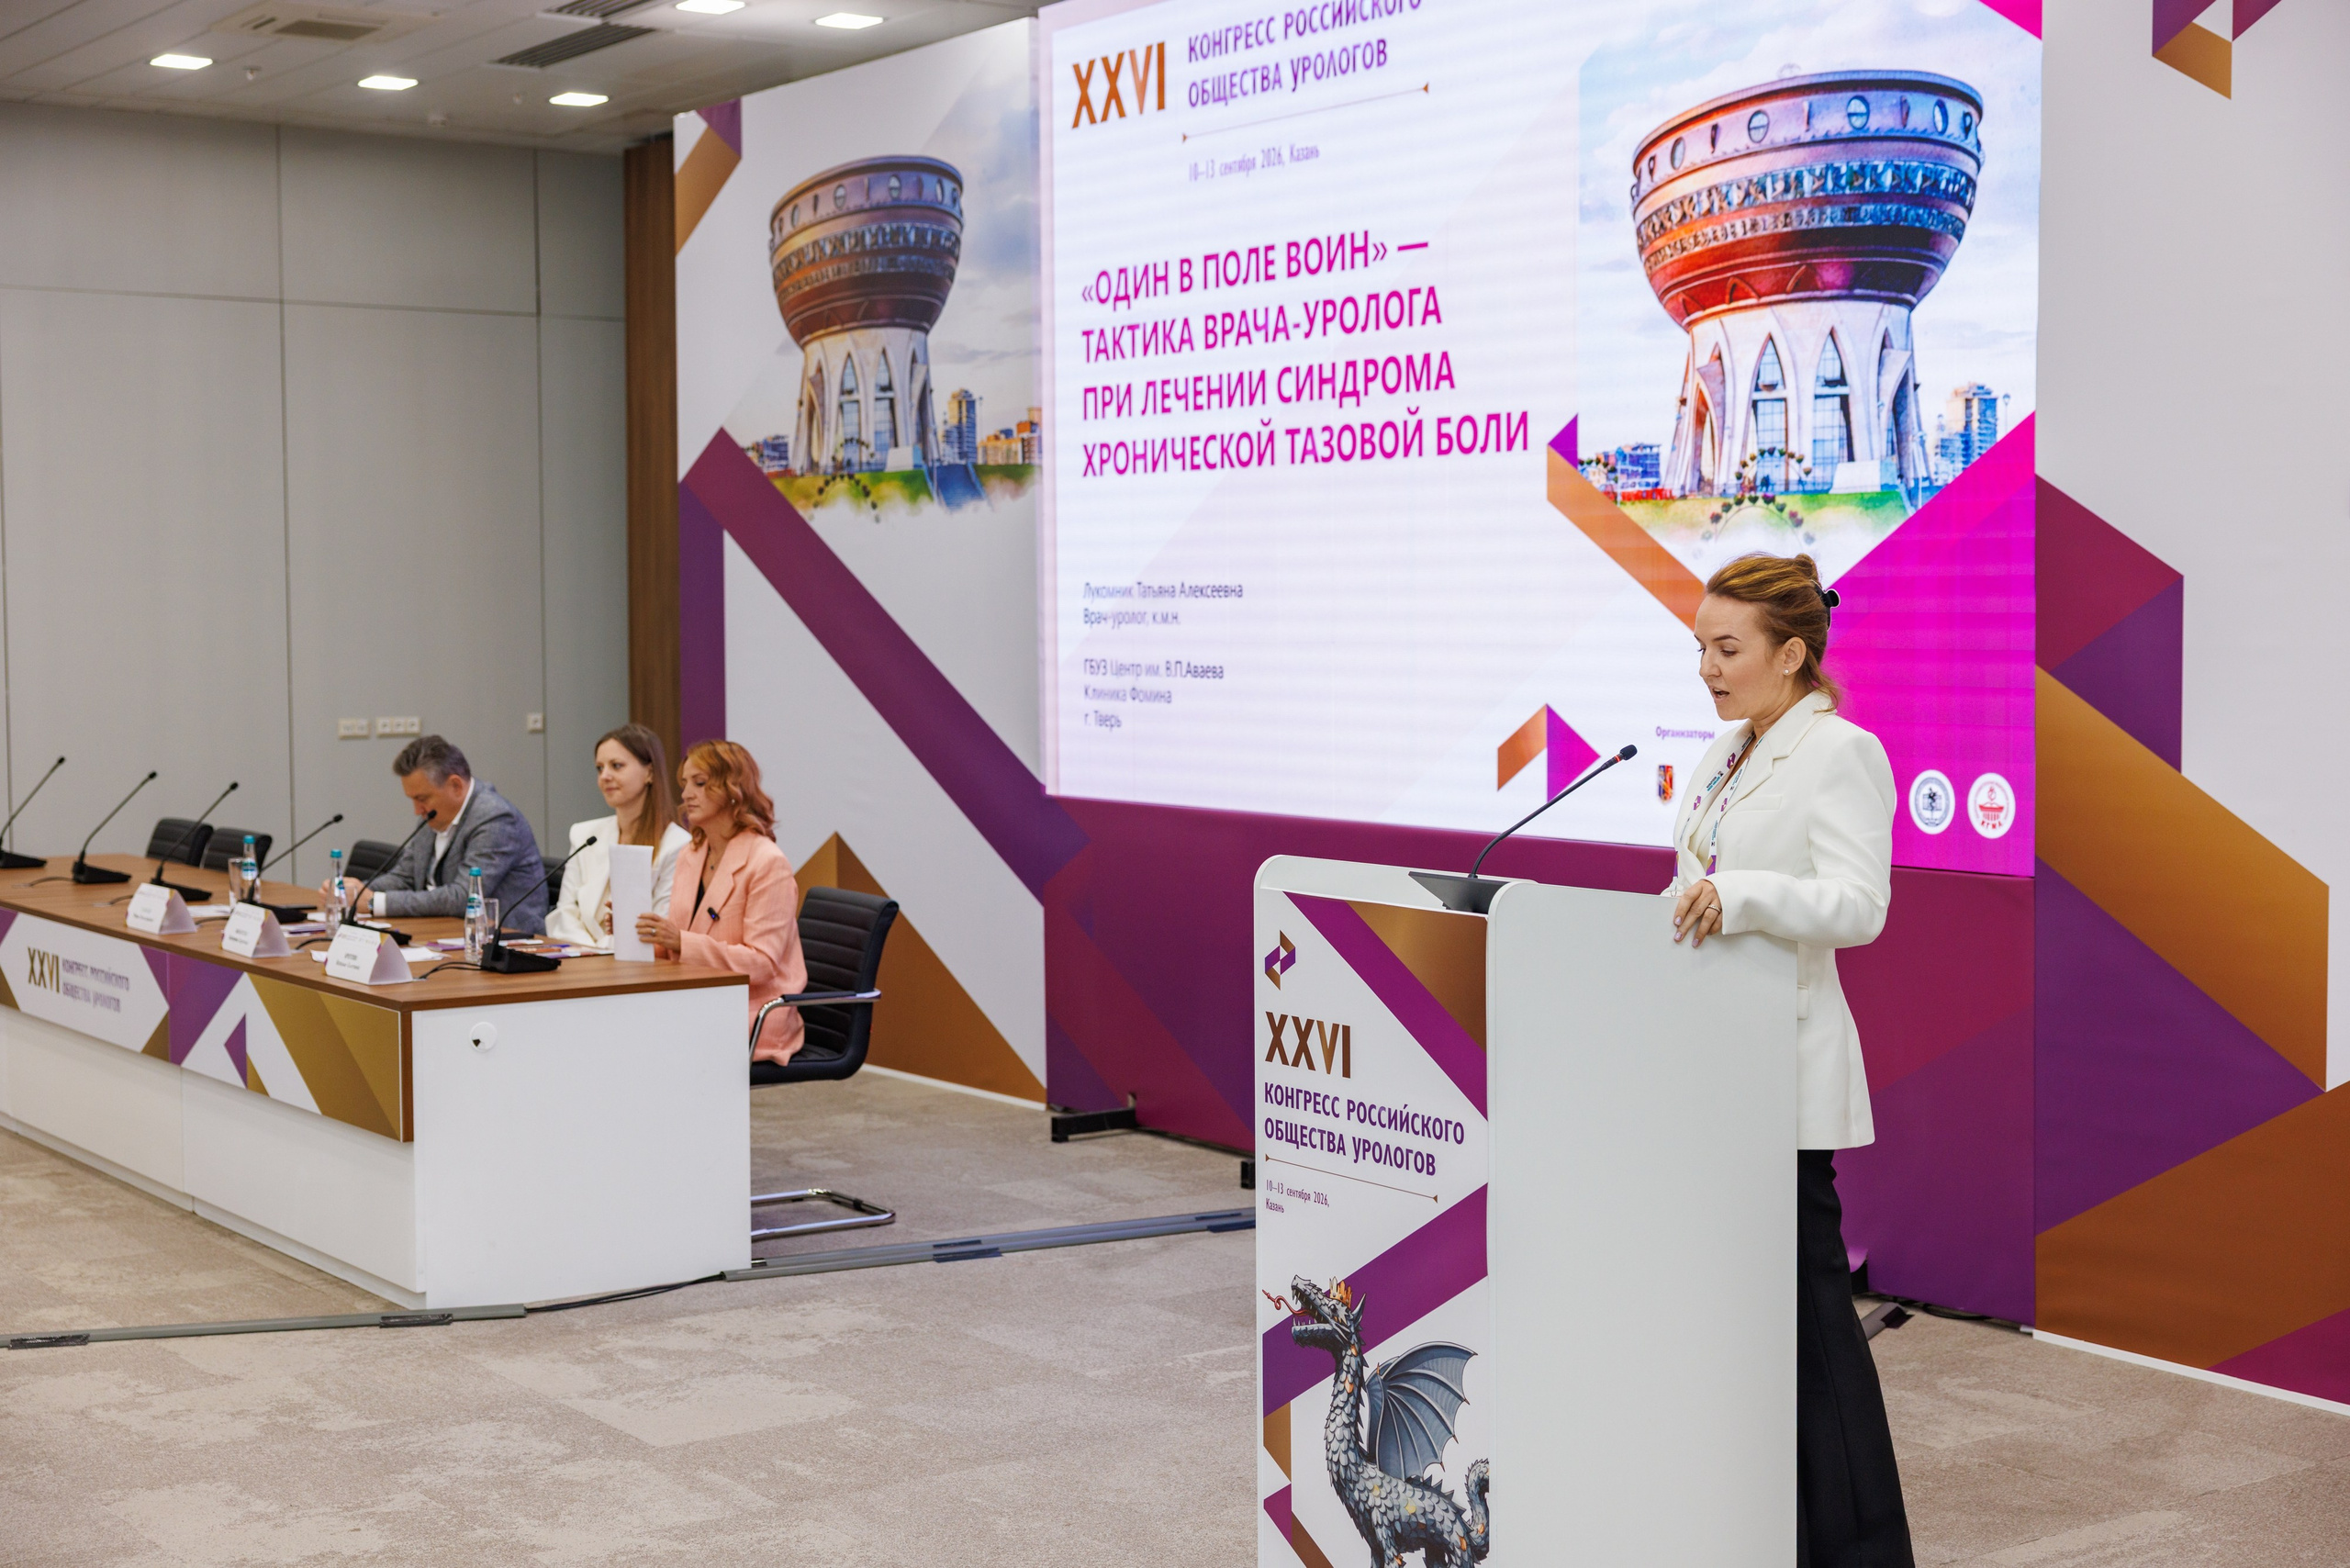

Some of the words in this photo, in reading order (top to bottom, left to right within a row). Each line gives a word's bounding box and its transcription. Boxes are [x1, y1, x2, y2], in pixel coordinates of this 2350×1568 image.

[1189, 17, 1276, 63] КОНГРЕСС
[1071, 41, 1166, 129] XXVI
[1189, 62, 1282, 108] ОБЩЕСТВА
[1290, 38, 1388, 93] УРОЛОГОВ
[1289, 143, 1319, 163] Казань
[1081, 267, 1169, 310] «ОДИН
[1179, 258, 1193, 293] В
[1203, 244, 1276, 289] ПОЛЕ
[1287, 230, 1387, 278] ВОИН»
[1081, 319, 1194, 364] ТАКТИКА
[1203, 285, 1443, 350] ВРАЧА-УРОЛОГА
[1083, 382, 1132, 420] ПРИ
[1141, 369, 1267, 416] ЛЕЧЕНИИ
[1277, 351, 1456, 408] СИНДРОМА
[1082, 418, 1275, 477] ХРОНИЧЕСКОЙ
[1285, 407, 1424, 465] ТАЗОВОЙ
[1436, 410, 1529, 456] БОЛИ
[1083, 582, 1133, 603] Лукомник
[1136, 581, 1176, 599] Татьяна
[1180, 581, 1244, 599] Алексеевна
[1084, 658, 1107, 677] ГБУЗ
[1111, 660, 1142, 680] Центр
[1084, 684, 1127, 701] Клиника
[1129, 687, 1172, 704] Фомина
[1094, 710, 1122, 732] Тверь
[28, 946, 60, 993] XXVI
[1265, 1011, 1350, 1079] XXVI
[1264, 1081, 1340, 1118] КОНГРЕСС
[1347, 1099, 1465, 1145] РОССИЙСКОГО
[1264, 1117, 1347, 1157] ОБЩЕСТВА
[1352, 1136, 1436, 1176] УРОЛОГОВ
[1266, 1197, 1285, 1214] Казань
[1286, 1188, 1311, 1204] сентября
[1314, 1191, 1330, 1207] 2026,
